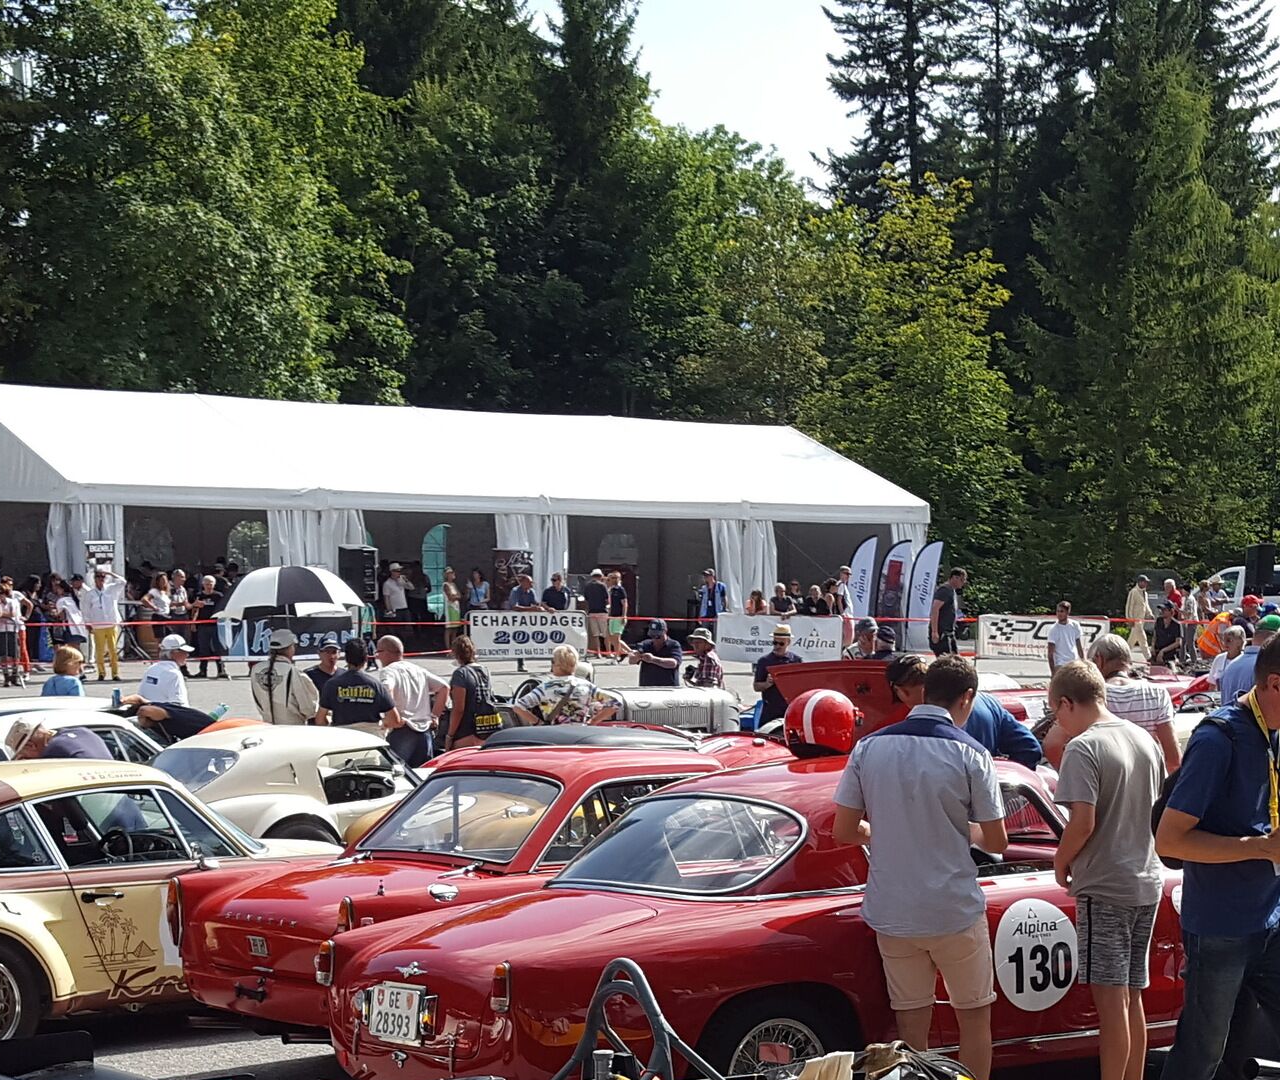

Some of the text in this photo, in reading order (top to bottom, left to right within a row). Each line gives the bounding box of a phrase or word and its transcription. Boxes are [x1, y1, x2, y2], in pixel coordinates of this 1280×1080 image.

[472, 615, 584, 627] ECHAFAUDAGES
[493, 630, 566, 644] 2000
[793, 637, 836, 649] Alpina
[1012, 919, 1057, 938] Alpina
[1007, 941, 1073, 994] 130
[389, 992, 400, 1009] GE
[375, 1011, 411, 1037] 28393
